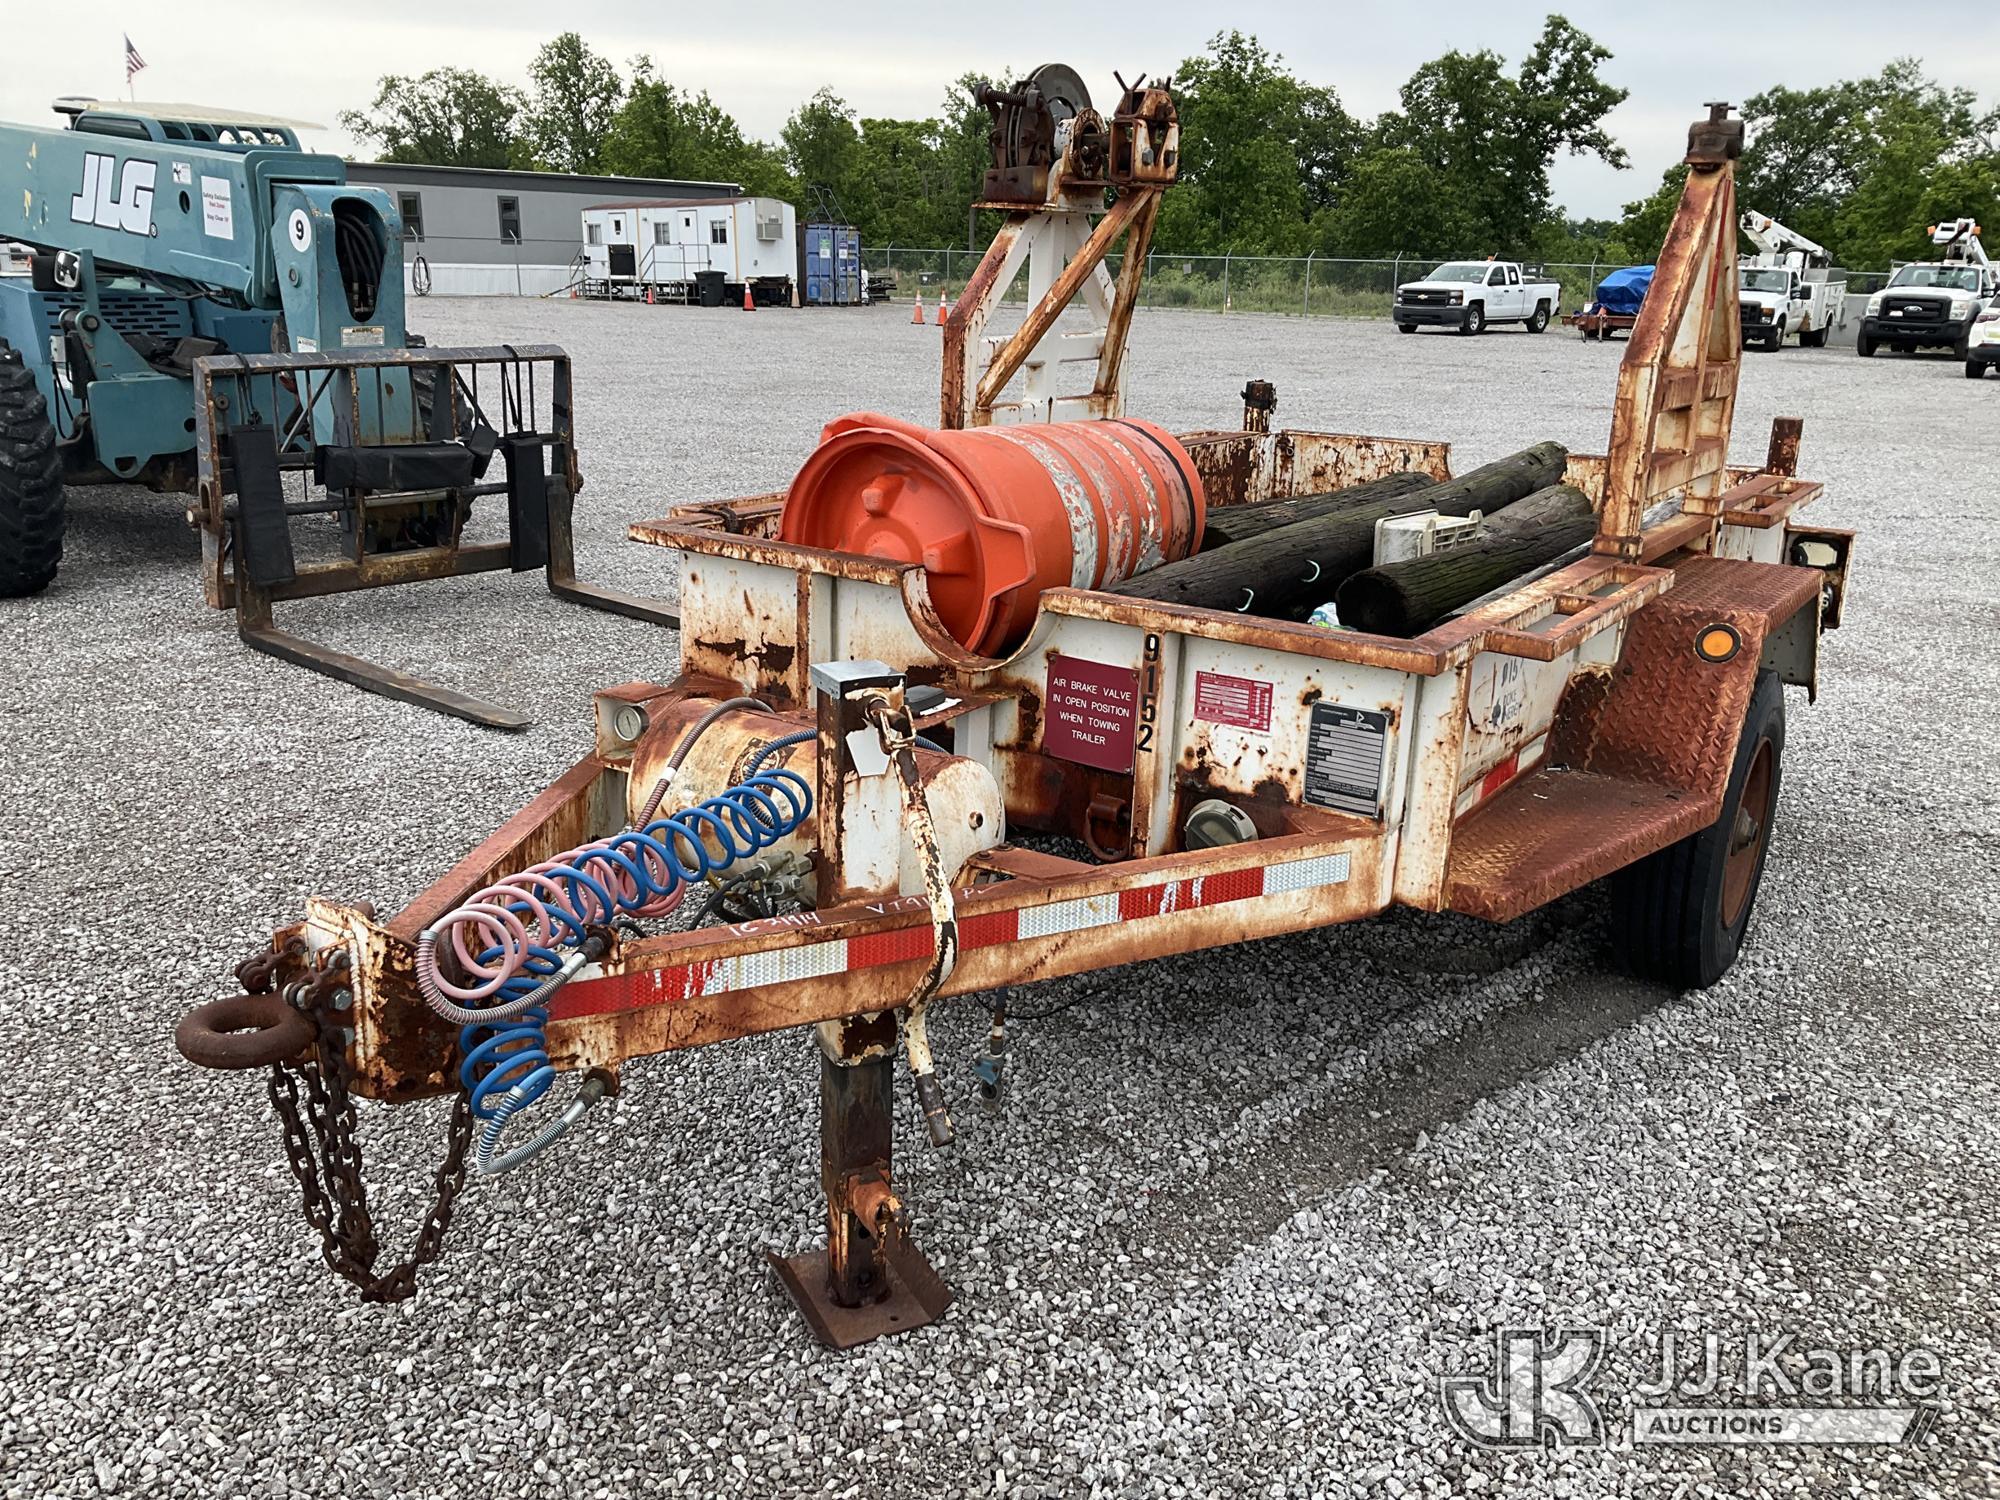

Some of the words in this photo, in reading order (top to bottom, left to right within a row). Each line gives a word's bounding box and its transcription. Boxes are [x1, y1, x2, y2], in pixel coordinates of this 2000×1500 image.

[71, 152, 158, 237] JLG
[296, 219, 304, 240] 9
[1053, 677, 1066, 688] AIR
[1071, 681, 1098, 694] BRAKE
[1103, 688, 1132, 701] VALVE
[1053, 694, 1061, 703] IN
[1065, 696, 1087, 708] OPEN
[1091, 702, 1130, 717] POSITION
[1060, 711, 1083, 724] WHEN
[1088, 717, 1120, 732] TOWING
[1071, 730, 1106, 745] TRAILER
